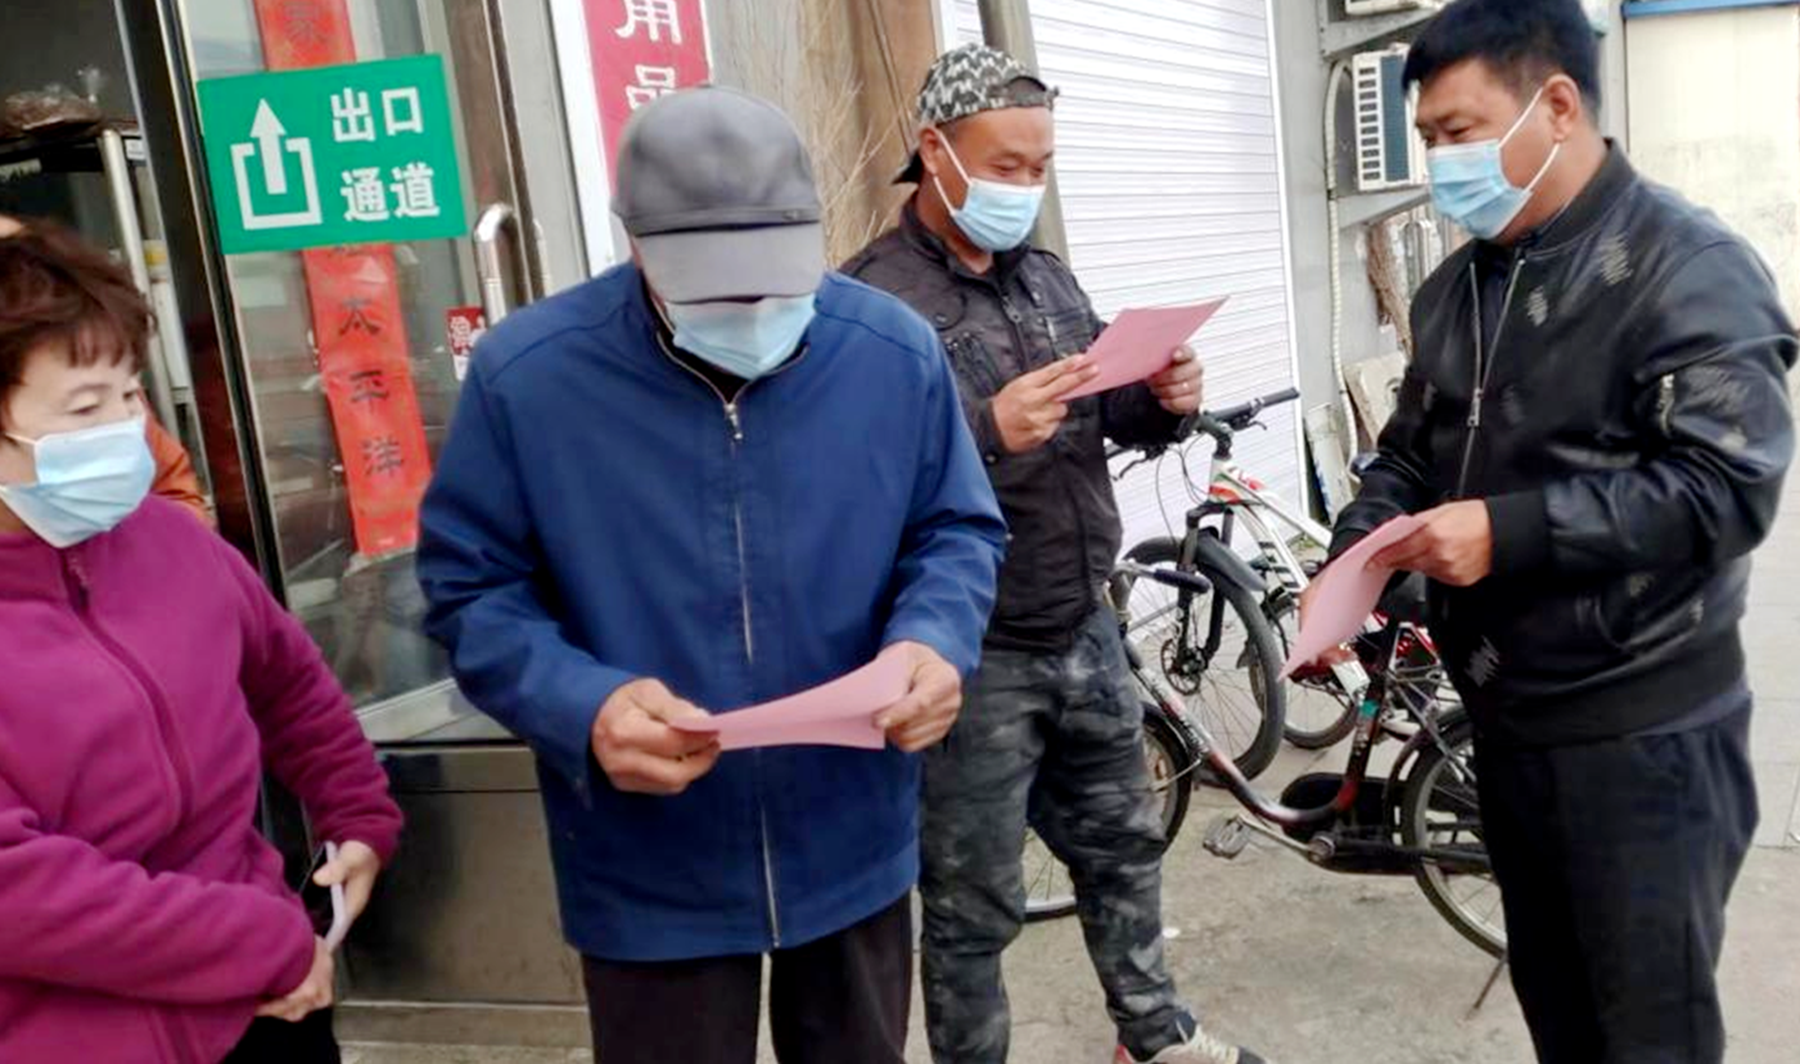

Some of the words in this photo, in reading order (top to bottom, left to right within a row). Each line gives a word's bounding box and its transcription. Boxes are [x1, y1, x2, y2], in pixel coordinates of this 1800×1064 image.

[614, 0, 682, 110] 用品
[330, 87, 424, 142] 出口
[340, 162, 441, 222] 通道
[327, 246, 405, 478] 太平洋
